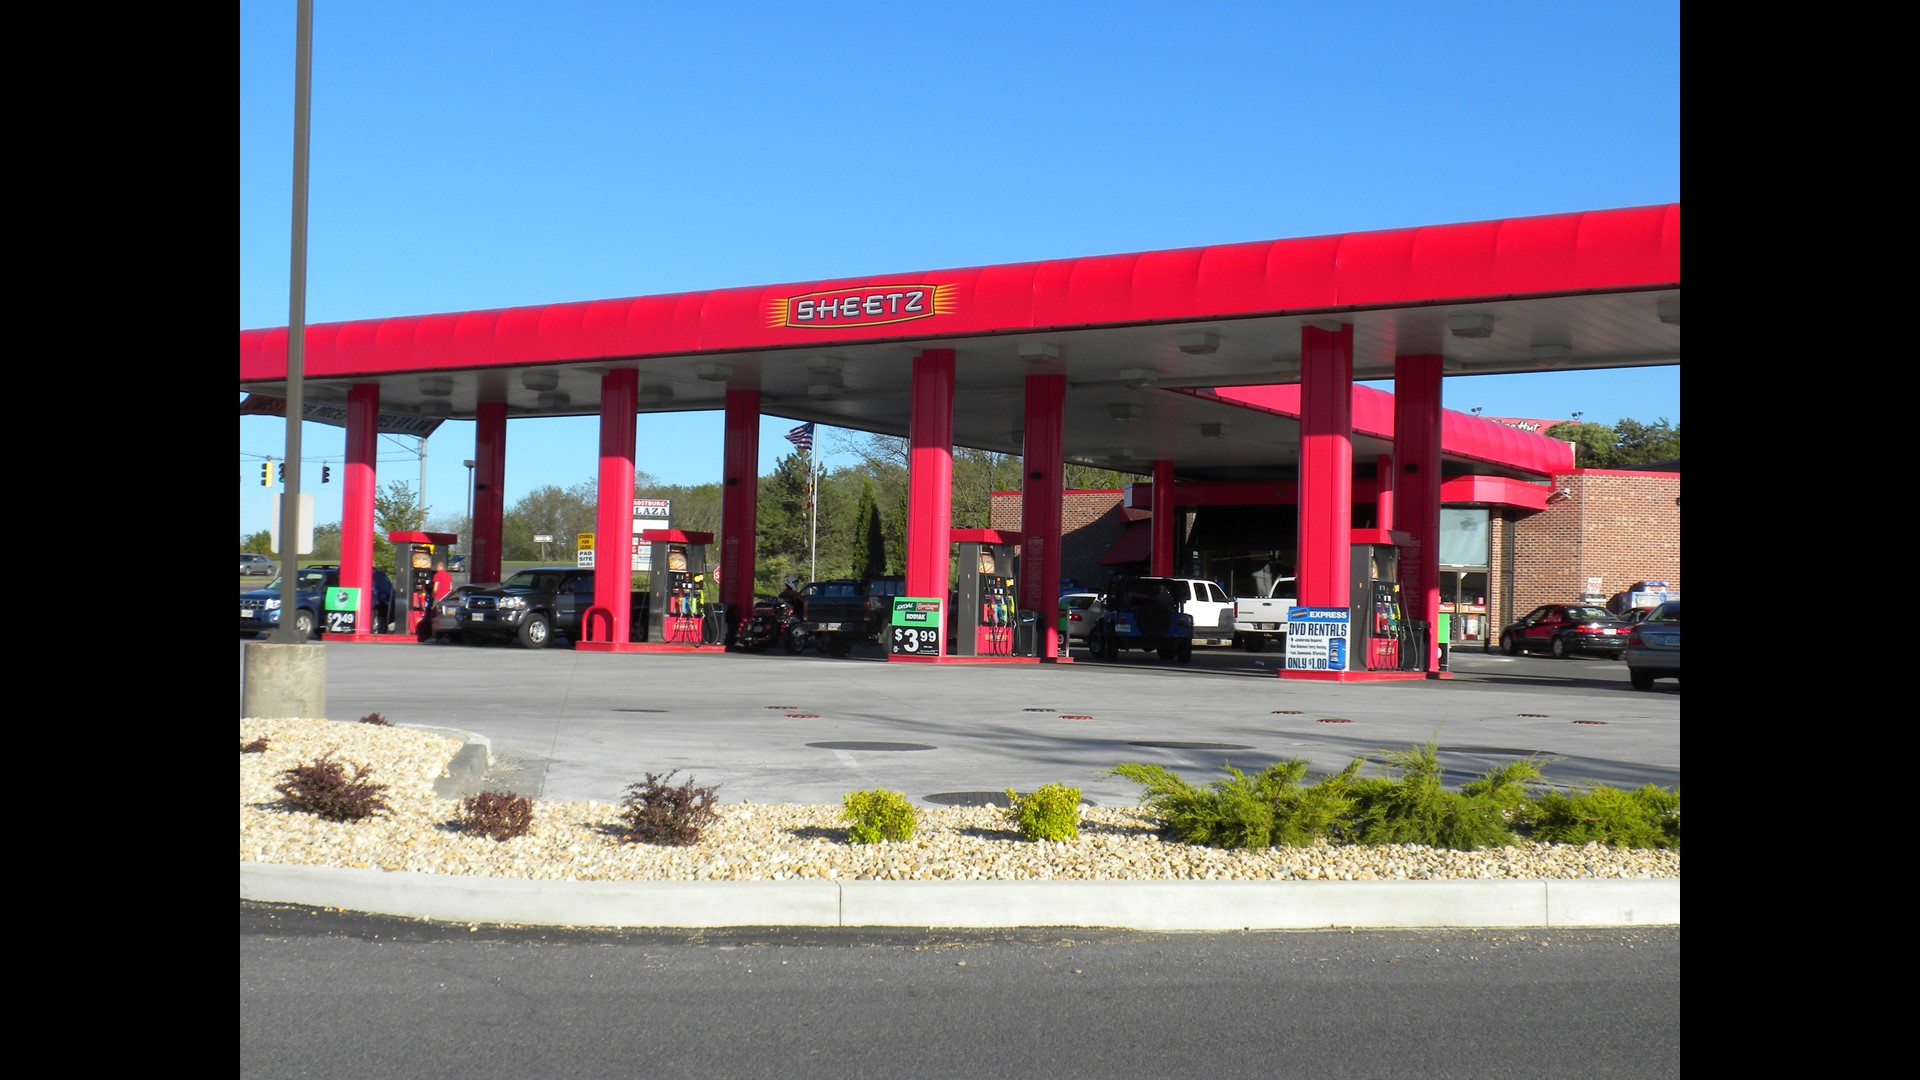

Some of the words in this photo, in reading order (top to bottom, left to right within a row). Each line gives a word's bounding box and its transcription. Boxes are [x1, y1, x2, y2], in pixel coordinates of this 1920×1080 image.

[797, 291, 924, 320] SHEETZ
[1517, 420, 1541, 432] Hut
[635, 507, 667, 515] LAZA
[1309, 611, 1347, 619] EXPRESS
[1289, 623, 1306, 635] DVD
[1308, 623, 1347, 636] RENTALS
[1288, 657, 1307, 669] ONLY
[1308, 658, 1327, 669] $1.00
